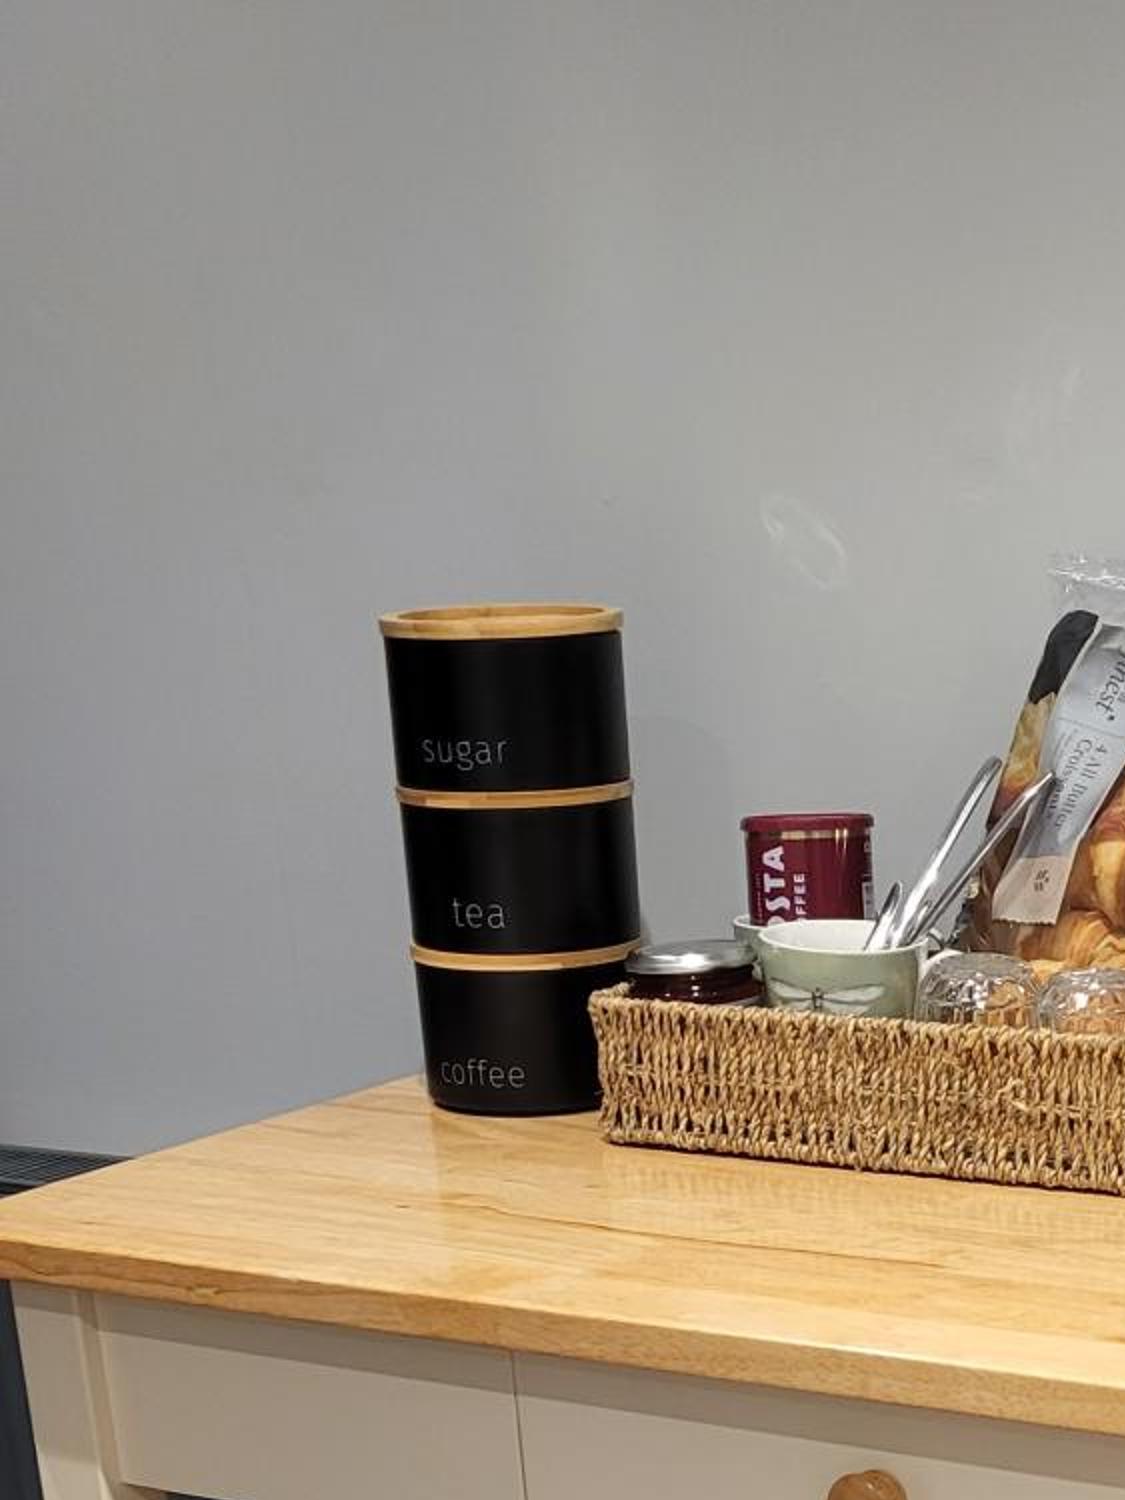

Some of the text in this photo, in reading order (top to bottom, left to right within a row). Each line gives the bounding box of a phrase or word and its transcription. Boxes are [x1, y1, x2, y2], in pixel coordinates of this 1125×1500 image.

[422, 739, 507, 771] sugar
[762, 845, 791, 926] STA
[793, 873, 807, 921] FFEE
[452, 897, 505, 929] tea
[441, 1058, 526, 1089] coffee
